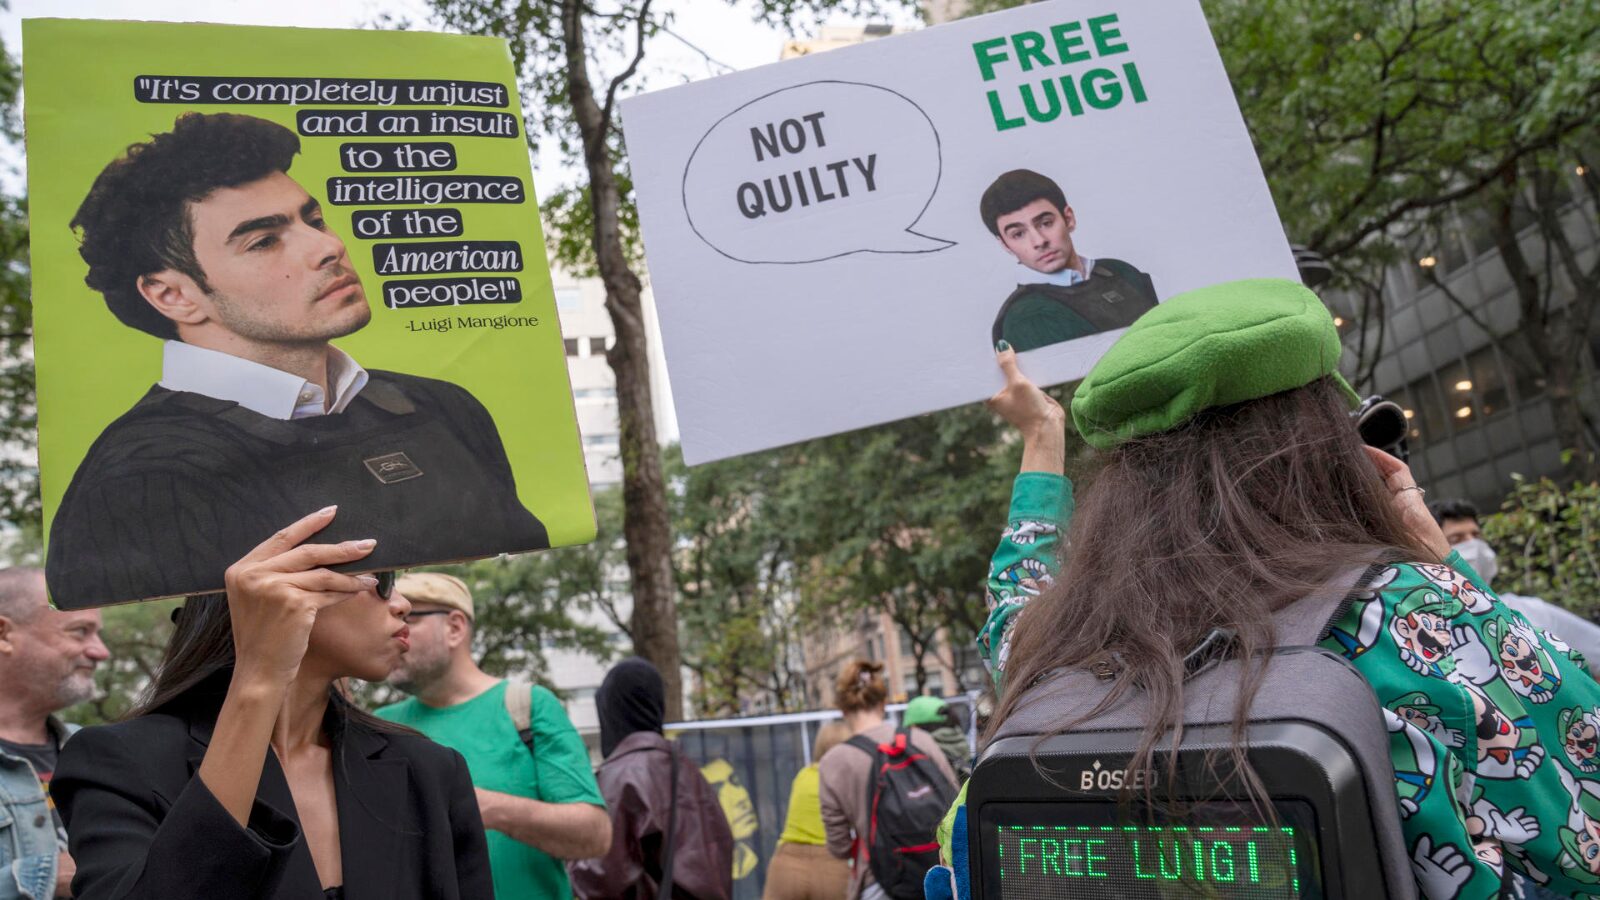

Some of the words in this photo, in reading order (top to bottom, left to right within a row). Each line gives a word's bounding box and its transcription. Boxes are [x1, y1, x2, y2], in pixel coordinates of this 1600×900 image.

[972, 13, 1130, 82] FREE
[139, 79, 201, 100] "It's
[212, 79, 397, 106] completely
[408, 82, 503, 106] unjust
[986, 62, 1148, 132] LUIGI
[302, 112, 368, 133] and
[378, 115, 420, 133] an
[430, 112, 513, 135] insult
[749, 111, 826, 162] NOT
[346, 146, 383, 169] to
[393, 144, 452, 168] the
[334, 178, 519, 205] intelligence
[736, 153, 877, 219] QUILTY
[357, 211, 392, 236] of
[402, 211, 458, 235] the
[380, 245, 519, 273] American
[388, 278, 516, 310] people!"
[405, 317, 453, 332] -Luigi
[458, 315, 539, 331] Mangione
[1019, 838, 1107, 877] FREE
[1133, 840, 1260, 883] LUIGI
